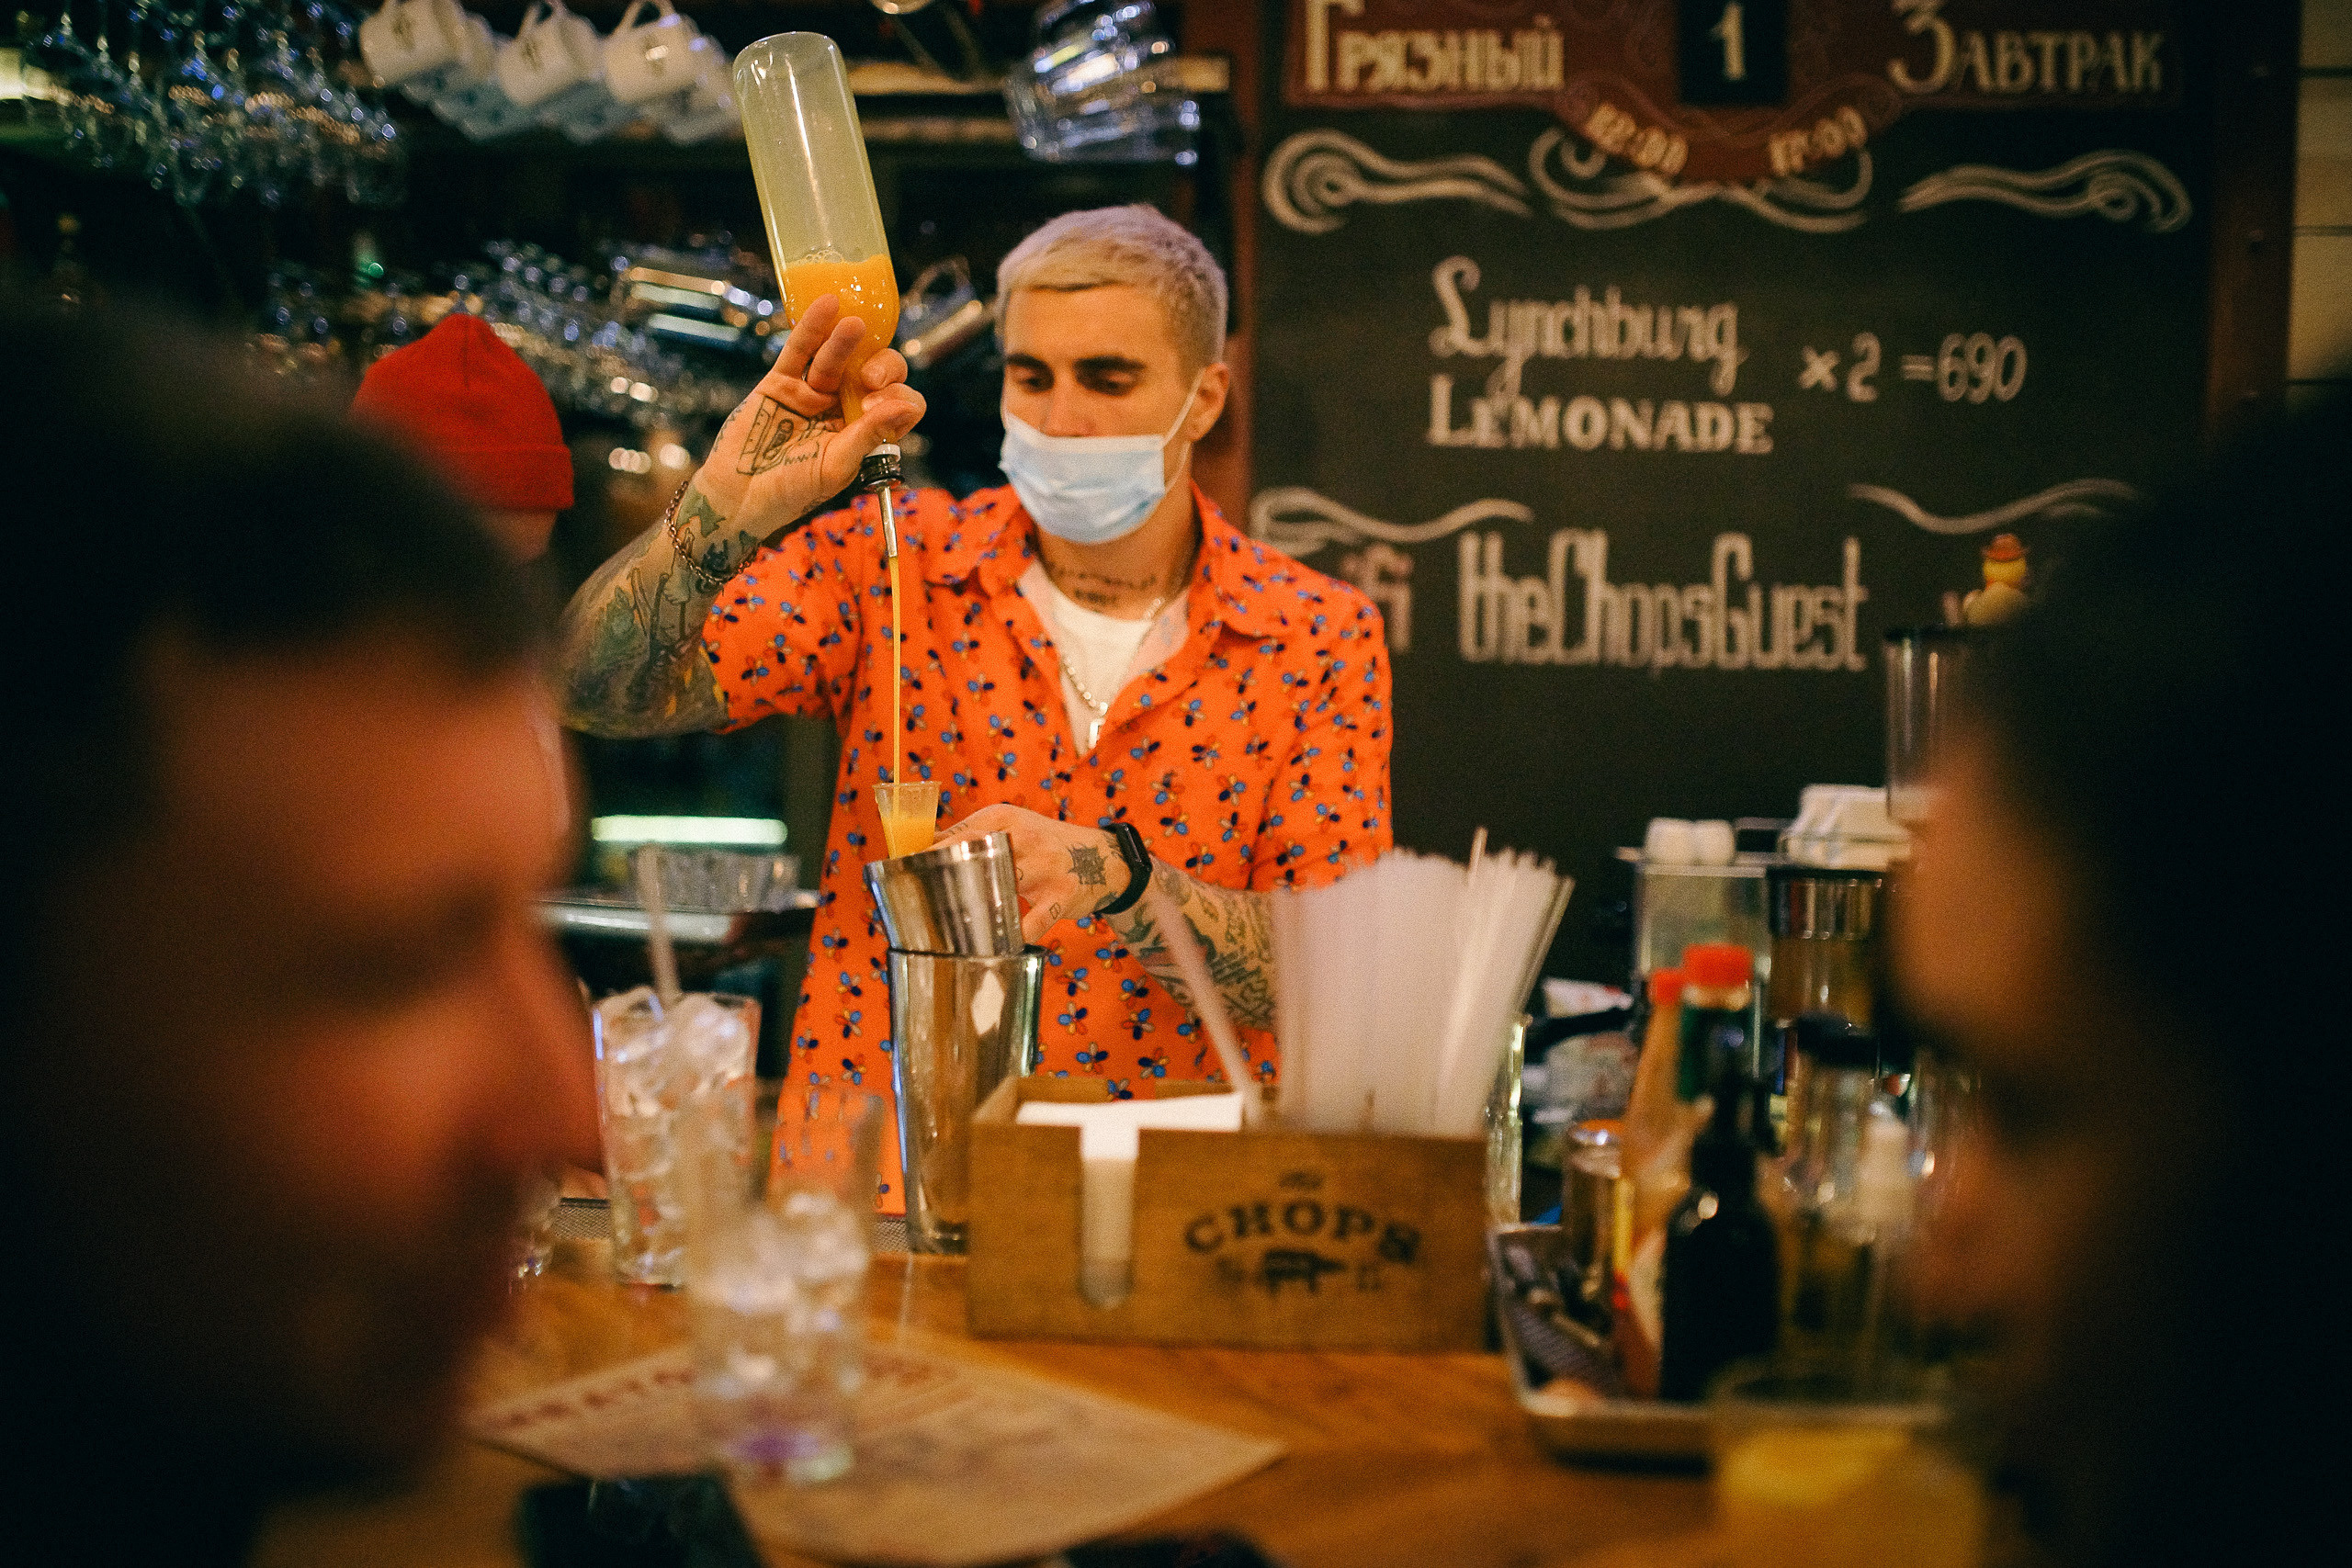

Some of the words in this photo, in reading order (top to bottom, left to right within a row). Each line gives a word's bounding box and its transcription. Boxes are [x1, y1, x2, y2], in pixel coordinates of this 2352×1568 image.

[1713, 2, 1745, 81] 1
[1429, 255, 1744, 397] Lynchburg
[1183, 1198, 1423, 1266] CHOPS
